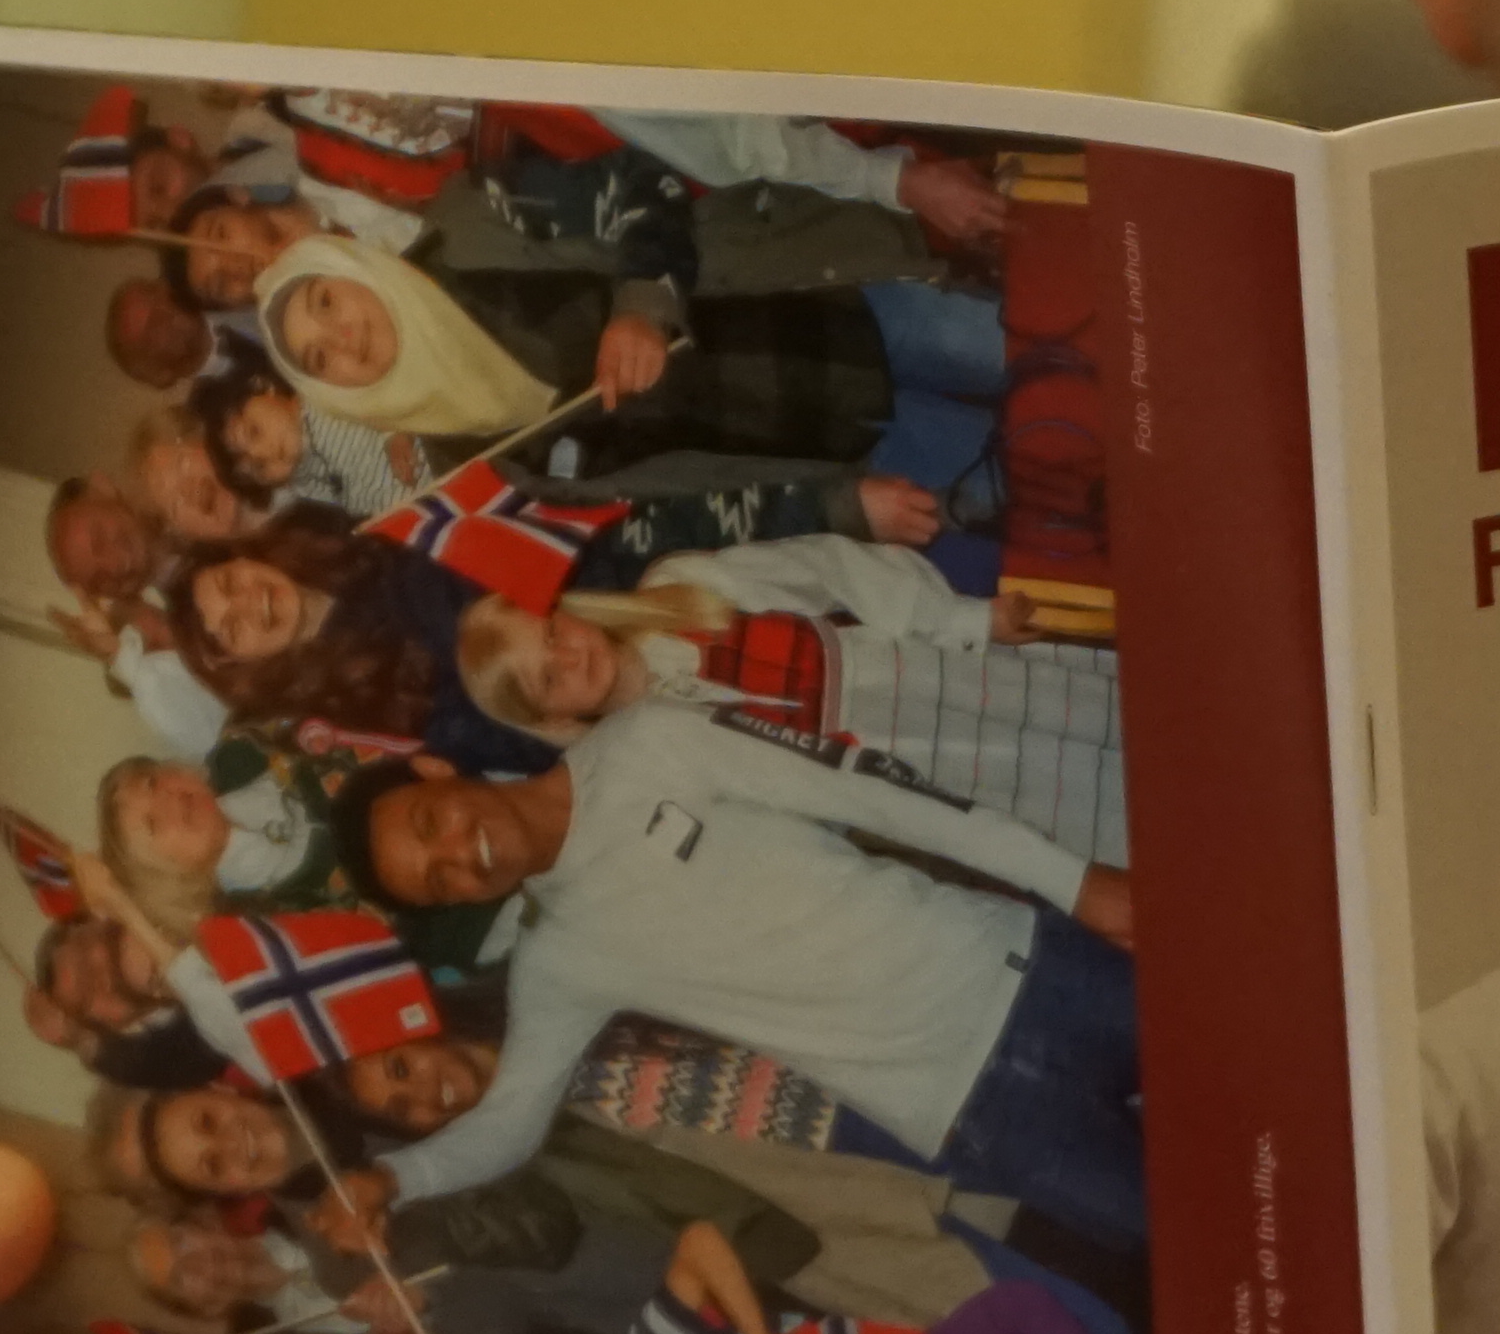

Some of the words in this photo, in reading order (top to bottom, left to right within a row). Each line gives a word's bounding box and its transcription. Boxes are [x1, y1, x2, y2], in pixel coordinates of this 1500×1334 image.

[1122, 220, 1145, 323] Lindholm
[1130, 330, 1148, 389] Peter
[1256, 1248, 1279, 1281] 60
[1264, 1287, 1286, 1318] og
